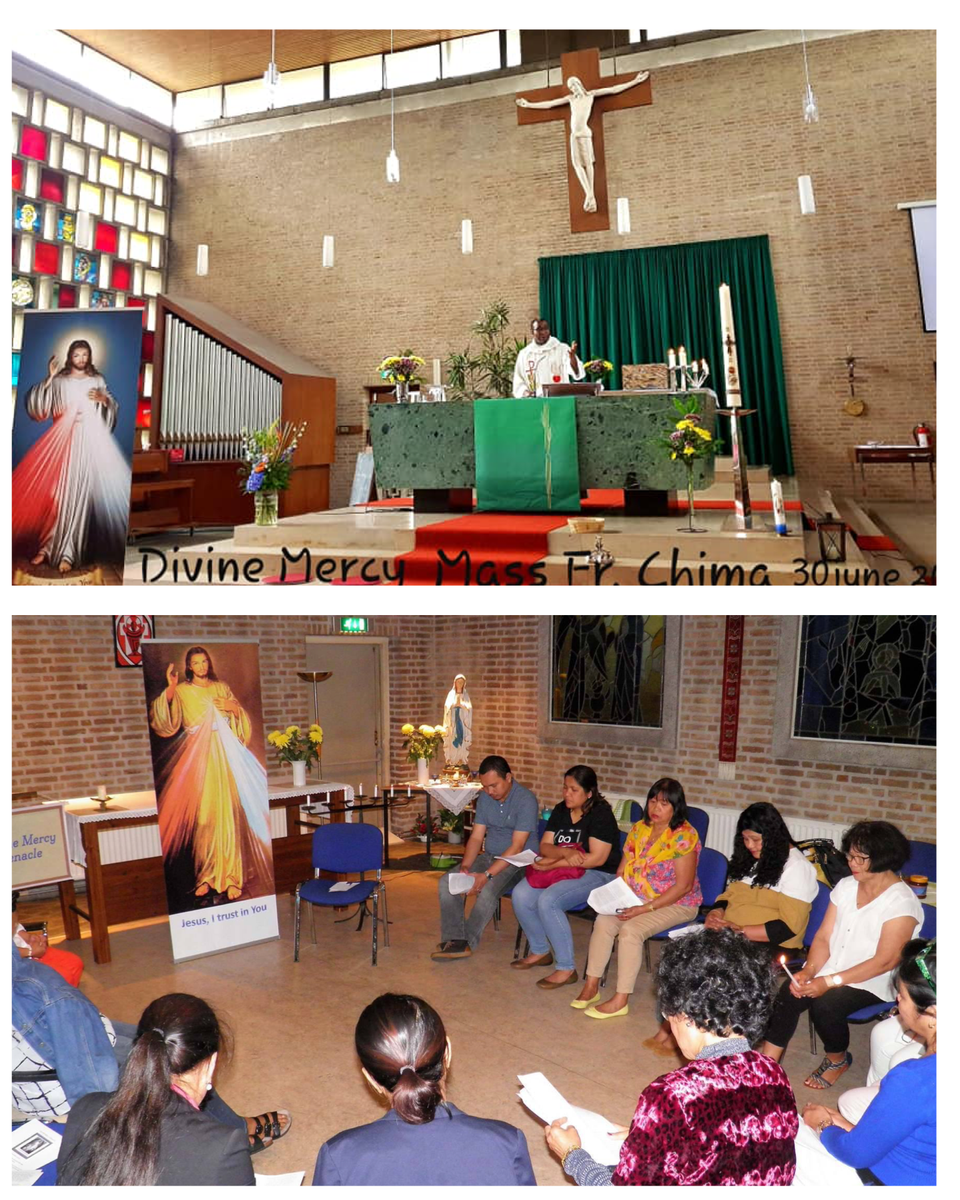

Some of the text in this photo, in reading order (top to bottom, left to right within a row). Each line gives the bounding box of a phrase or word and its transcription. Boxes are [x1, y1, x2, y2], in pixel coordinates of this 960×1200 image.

[21, 834, 57, 847] Mercy
[181, 904, 268, 928] Jesus, I trust in You
